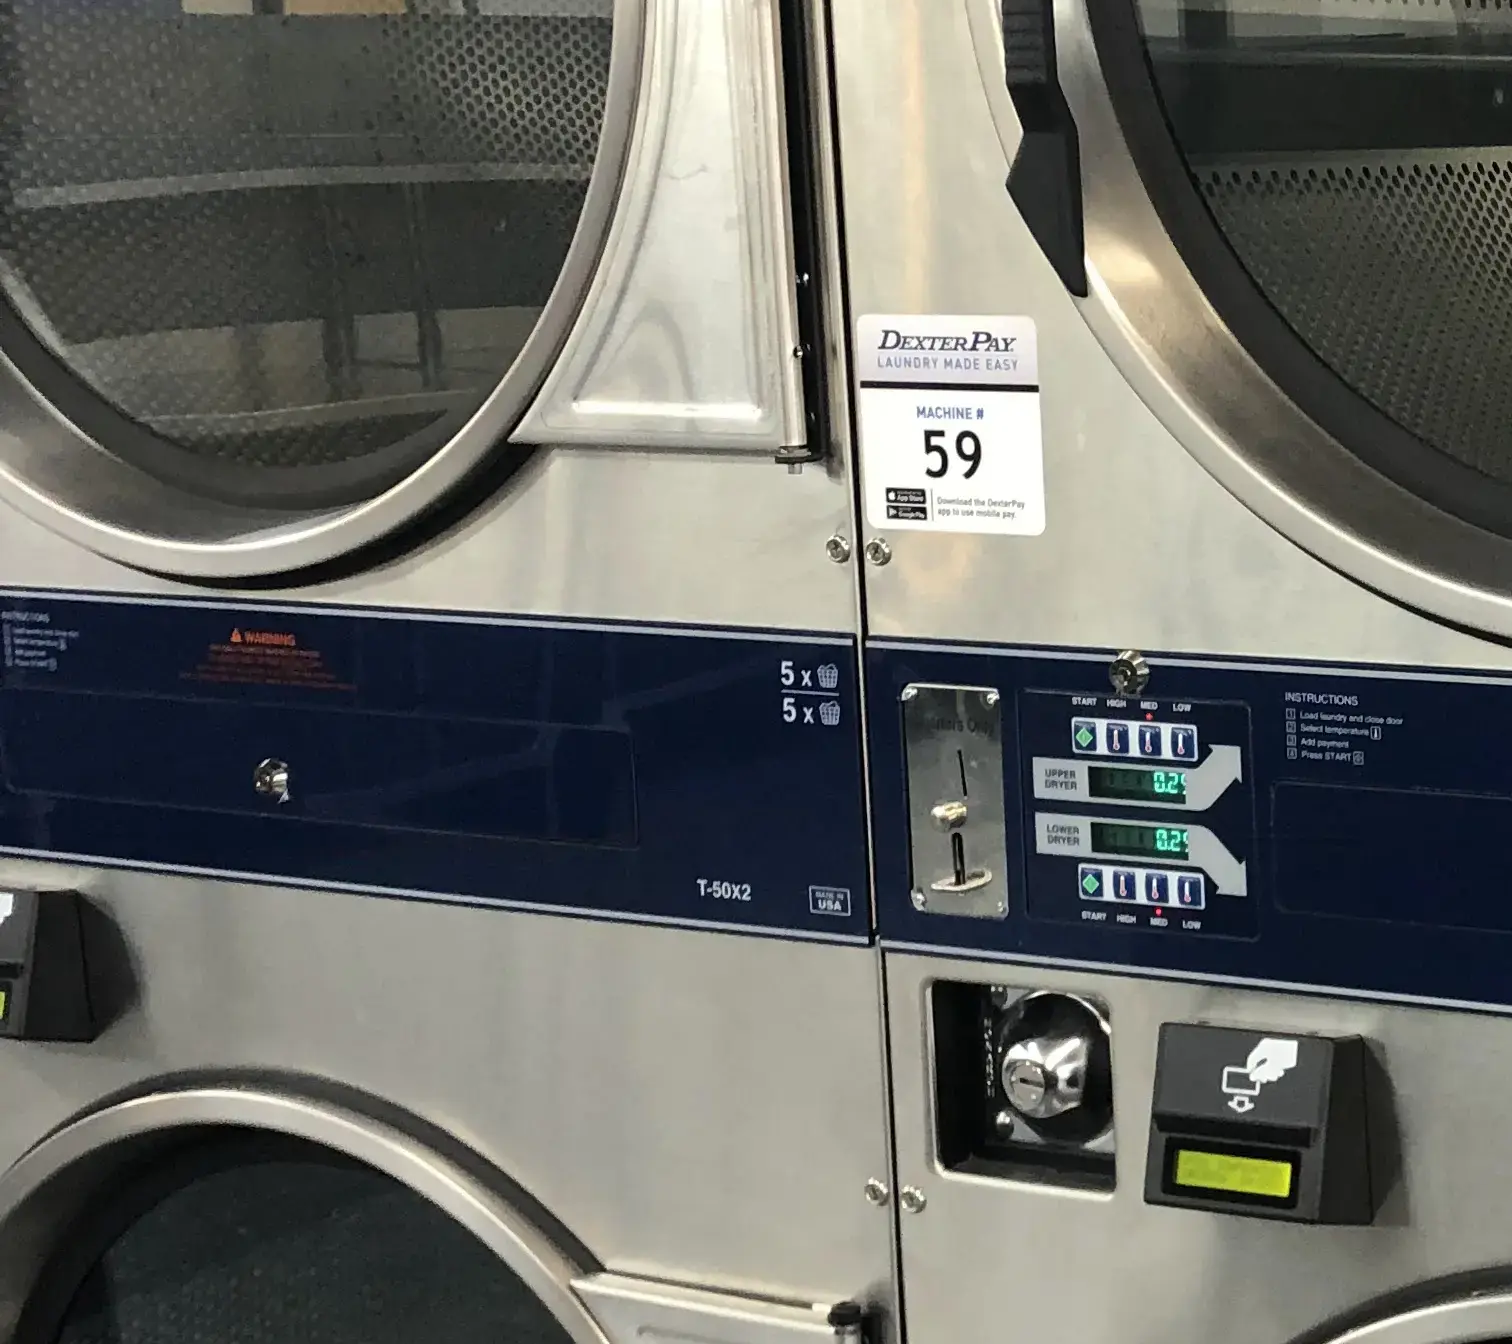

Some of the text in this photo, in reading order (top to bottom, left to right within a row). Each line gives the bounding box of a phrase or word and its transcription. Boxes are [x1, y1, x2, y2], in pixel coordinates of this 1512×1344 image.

[877, 356, 1018, 372] LAUNDRY MADE EASY
[916, 406, 985, 420] MACHINE #
[923, 429, 983, 480] 59
[780, 660, 812, 687] 5 x
[1072, 696, 1192, 712] START HIGH MED LOW
[1285, 692, 1359, 706] INSTRUCTIONS
[782, 698, 815, 724] 5 x
[1325, 751, 1352, 762] START
[1044, 768, 1076, 779] UPPER
[1044, 780, 1078, 791] DRYER
[1046, 824, 1080, 834] LOWER
[1047, 835, 1080, 846] DRYER
[696, 879, 752, 902] T-50X2
[818, 899, 842, 911] USA
[1081, 910, 1202, 930] START HIGH MED LOW
